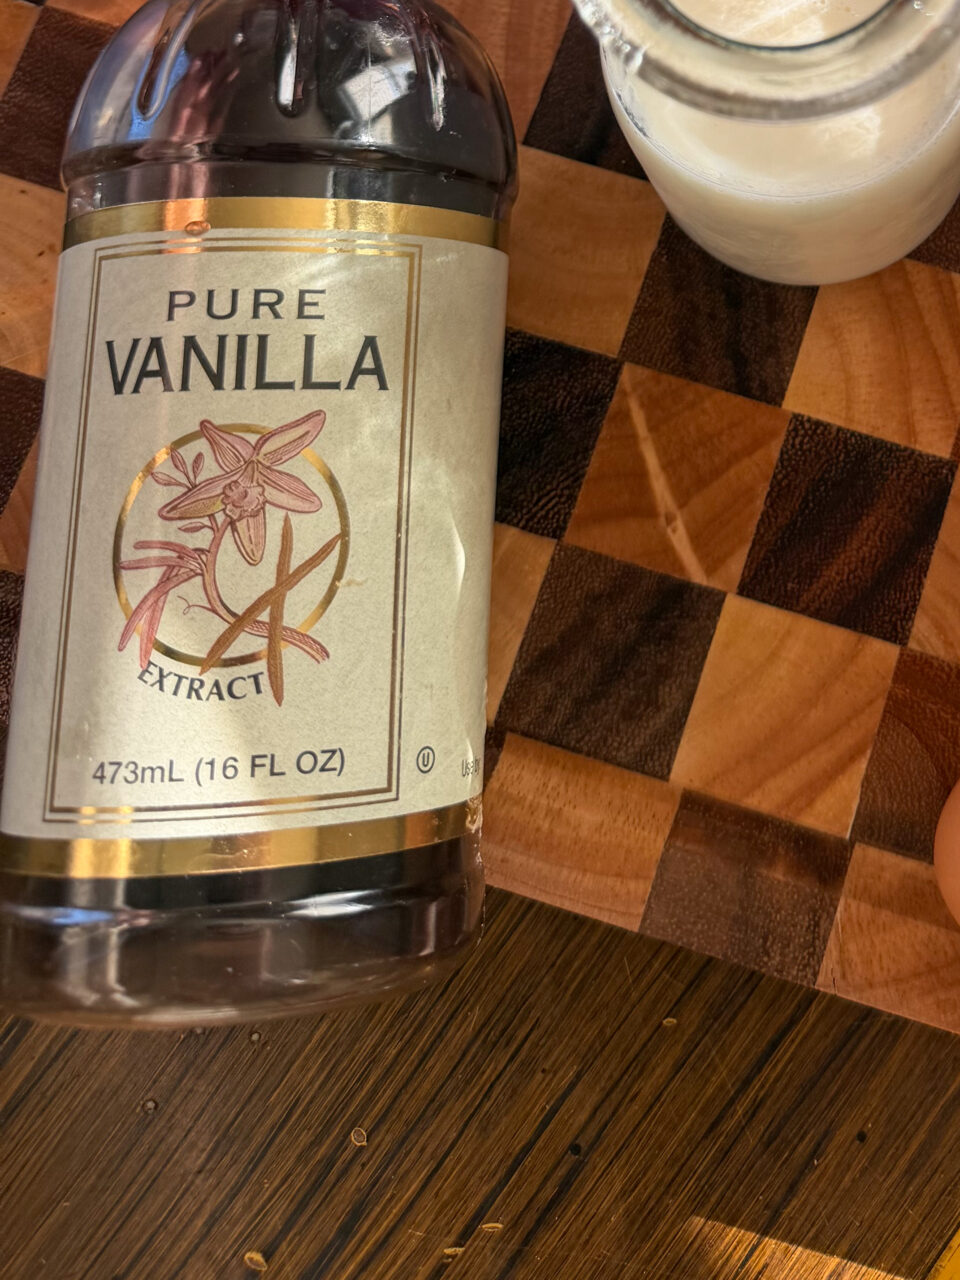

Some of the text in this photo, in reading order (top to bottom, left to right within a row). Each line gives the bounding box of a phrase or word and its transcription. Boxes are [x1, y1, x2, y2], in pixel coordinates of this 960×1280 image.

[167, 288, 326, 322] PURE
[106, 333, 390, 396] VANILLA
[138, 659, 264, 702] EXTRACT
[92, 747, 345, 788] 473mL (16 FL OZ)
